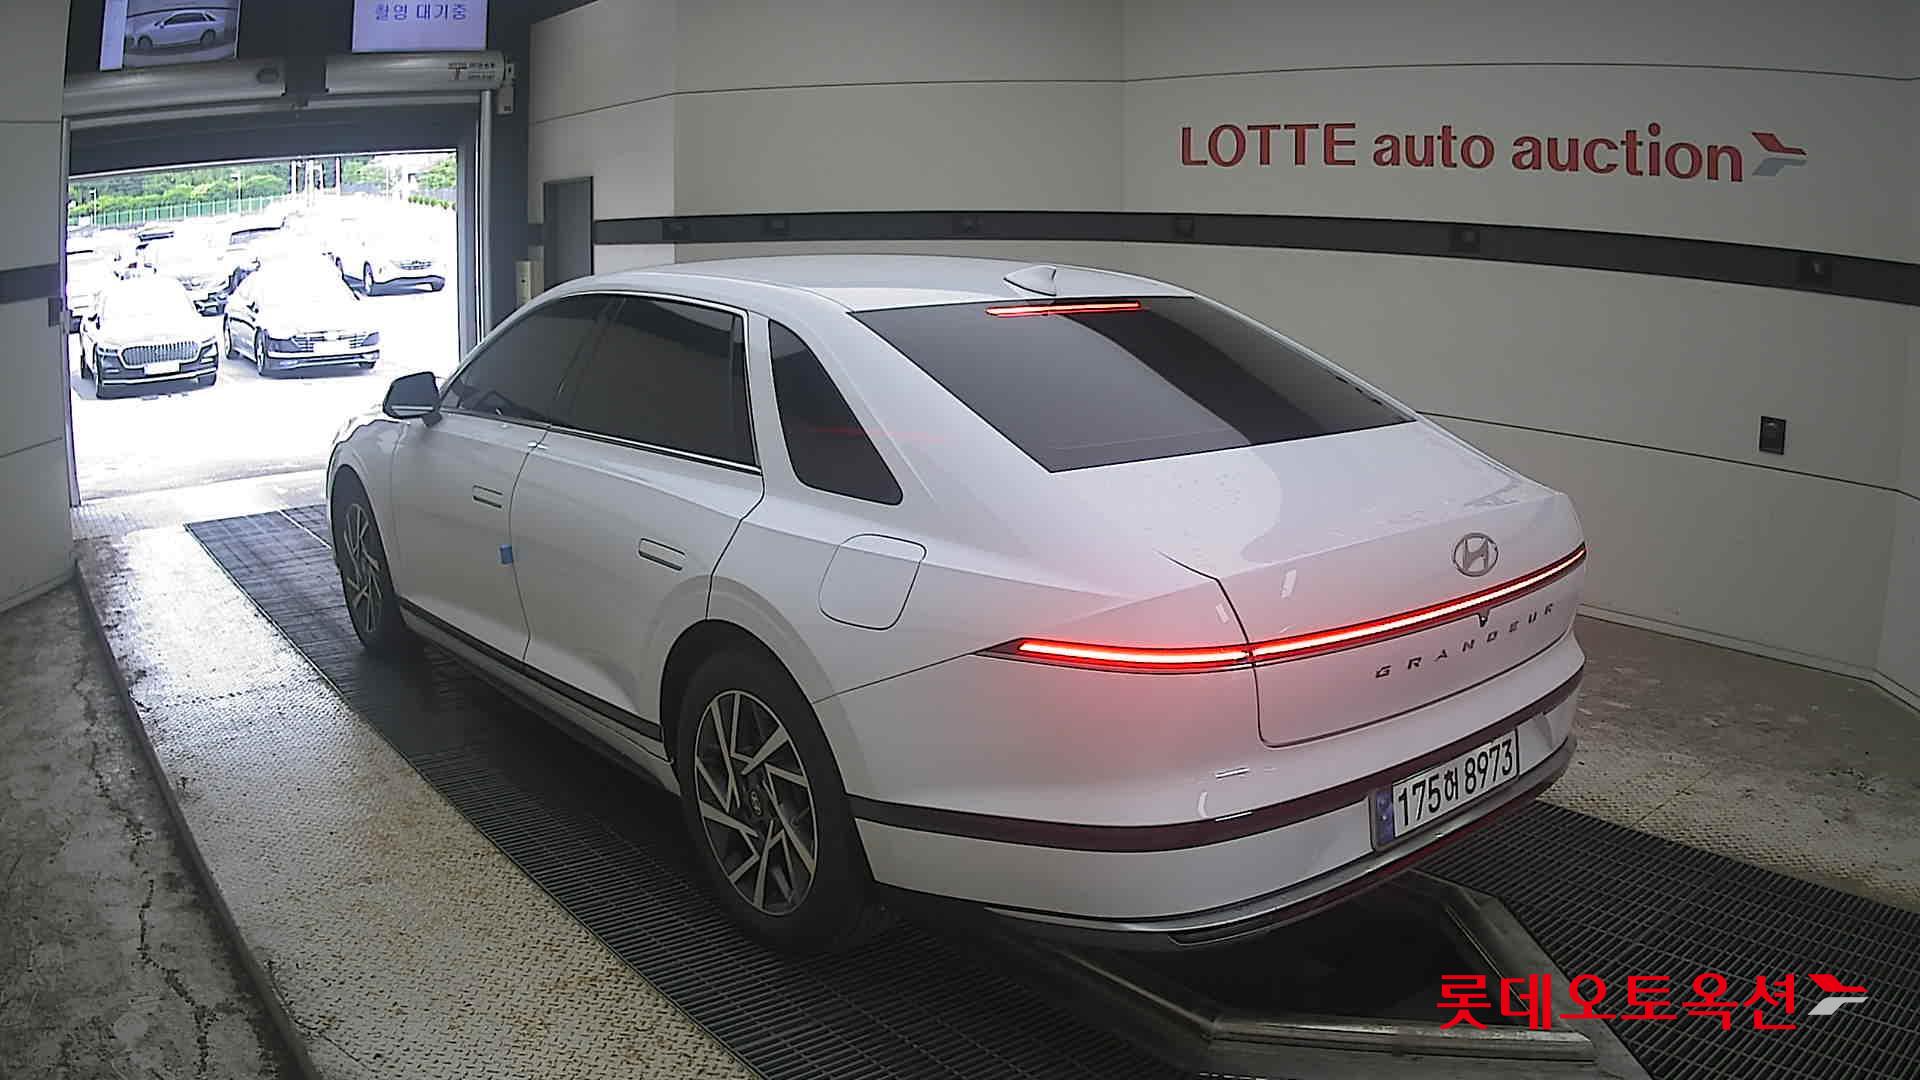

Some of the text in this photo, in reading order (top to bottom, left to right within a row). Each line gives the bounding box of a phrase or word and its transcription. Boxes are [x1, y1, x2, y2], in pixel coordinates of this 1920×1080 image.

[416, 3, 466, 20] 대기중
[1180, 122, 1744, 183] LOTTE auto auction
[1375, 602, 1555, 679] GRANDEUR
[1464, 738, 1513, 795] 8973
